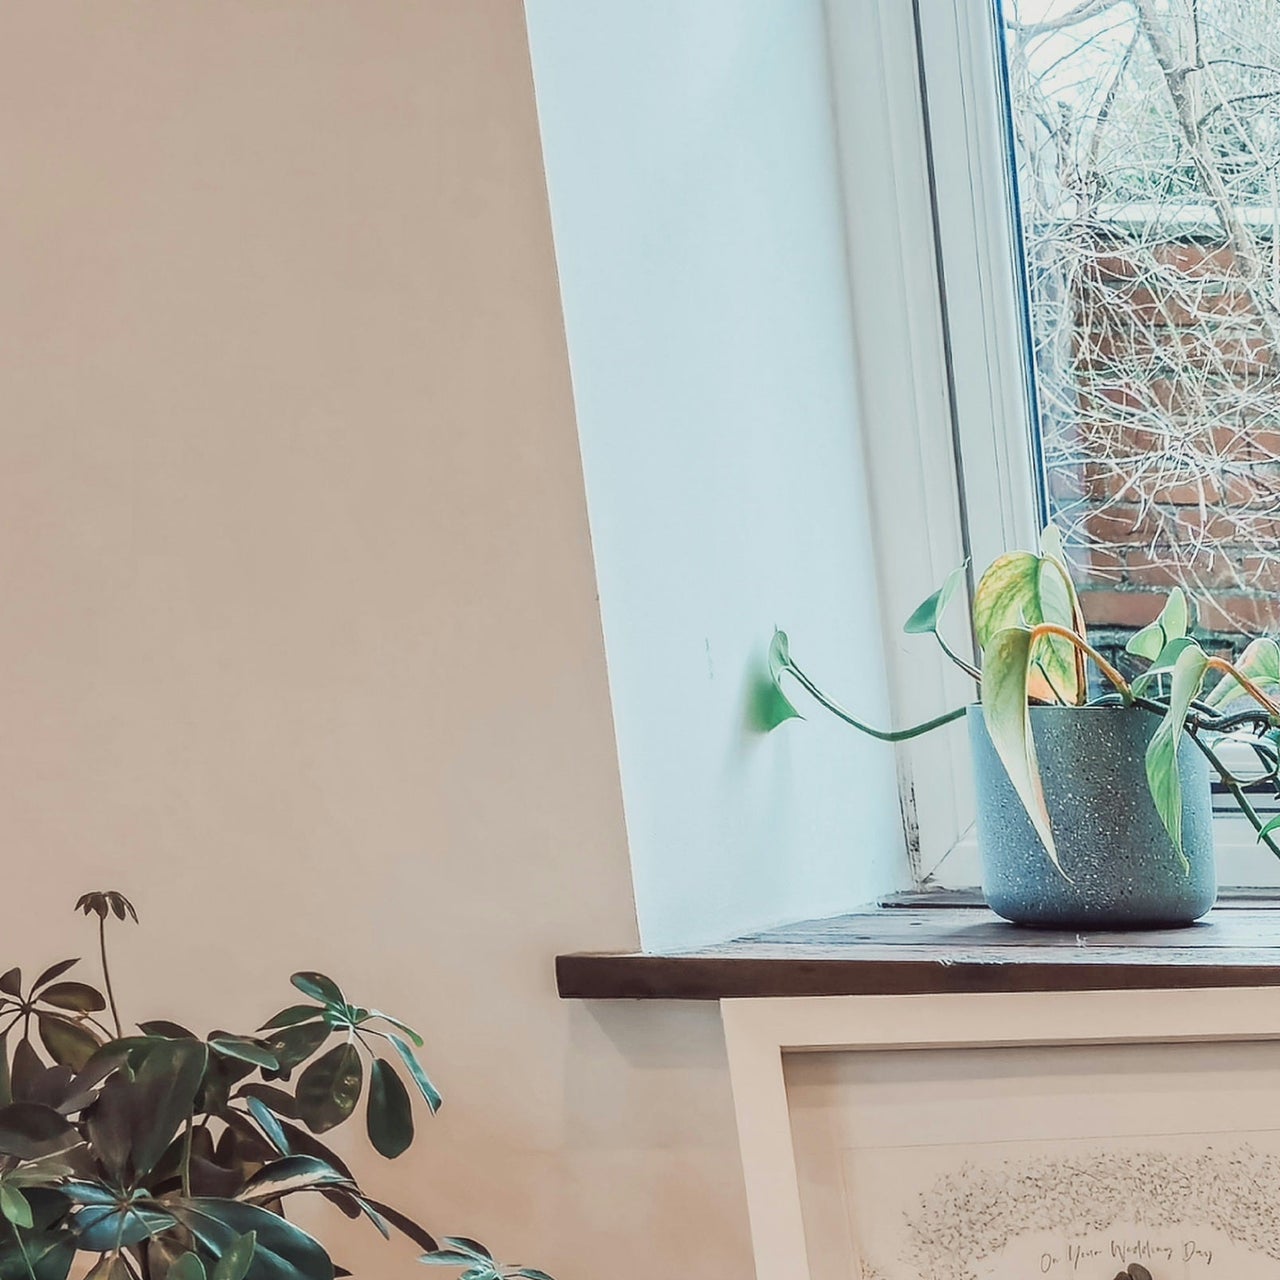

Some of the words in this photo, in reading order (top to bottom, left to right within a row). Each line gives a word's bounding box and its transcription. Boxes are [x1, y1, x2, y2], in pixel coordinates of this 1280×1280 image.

[1068, 1244, 1102, 1270] Your
[1110, 1240, 1173, 1263] Wedding
[1183, 1240, 1213, 1265] Day
